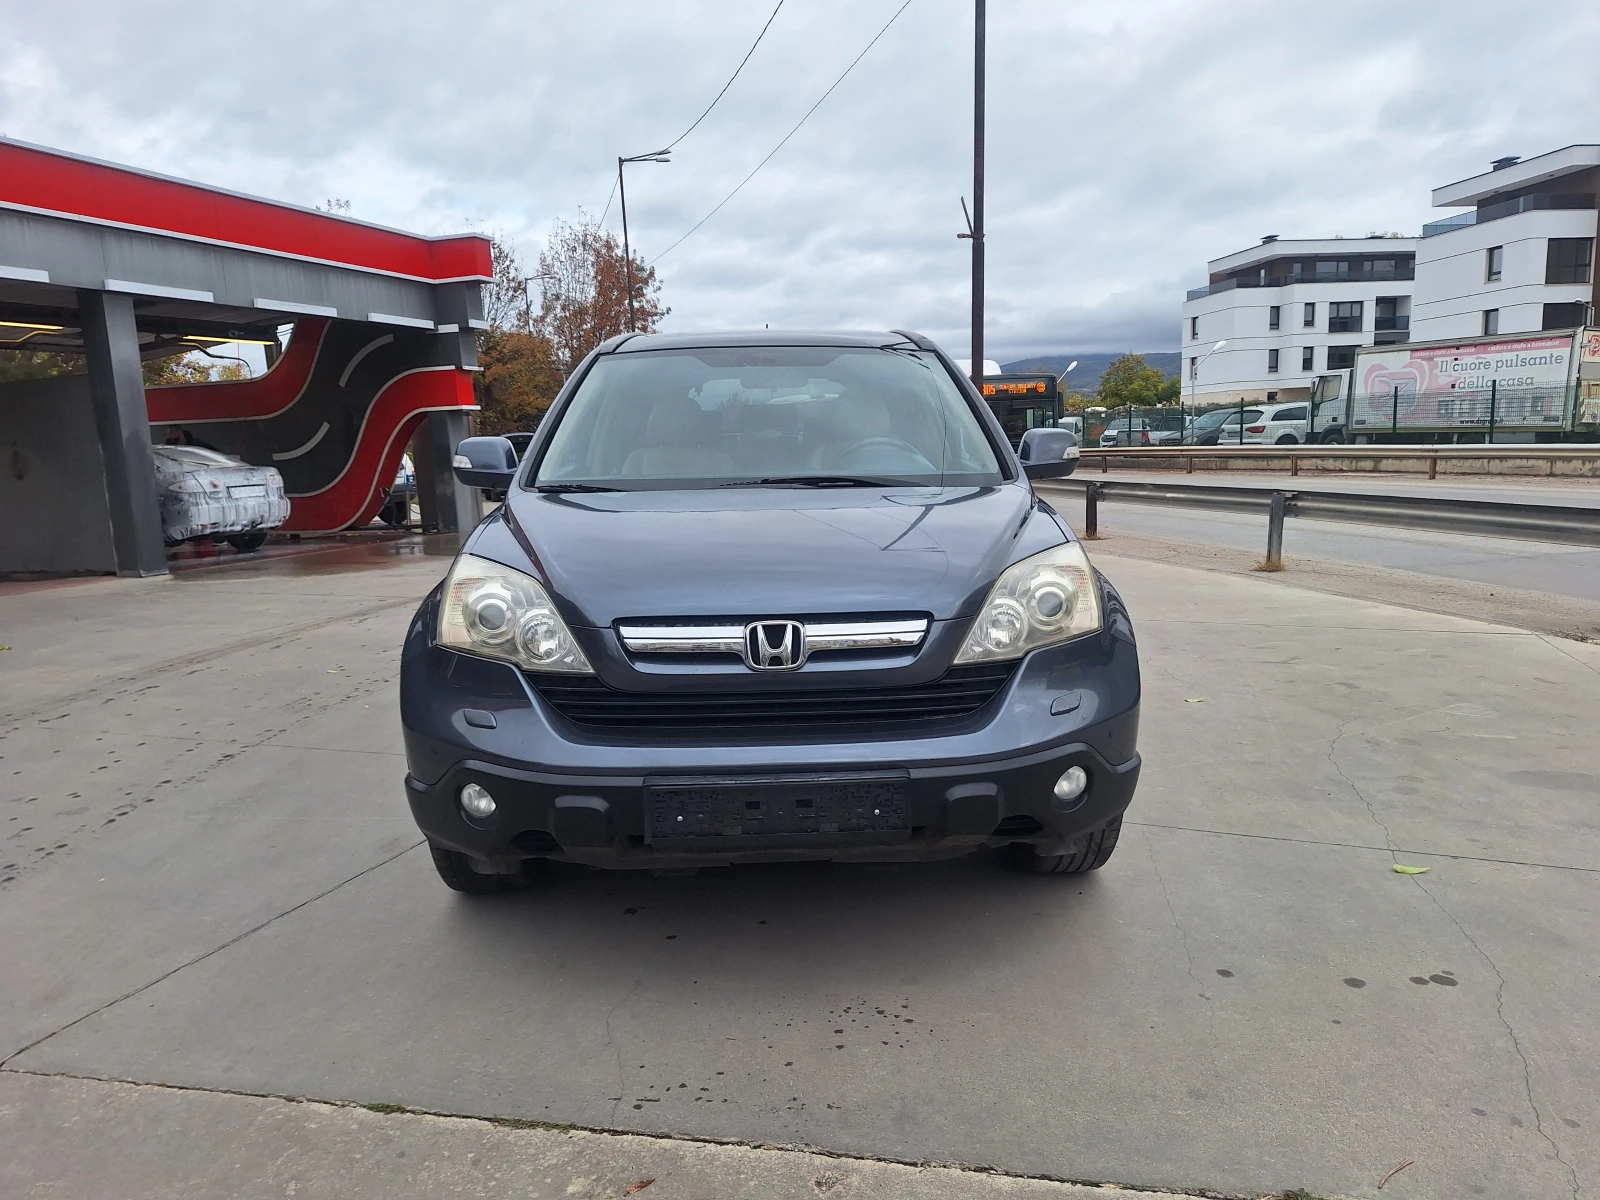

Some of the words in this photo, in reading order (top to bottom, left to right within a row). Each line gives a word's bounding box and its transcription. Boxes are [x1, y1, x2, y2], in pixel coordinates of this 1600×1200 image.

[1439, 360, 1449, 373] Il
[1452, 360, 1492, 372] cuore
[1494, 353, 1564, 372] pulsante
[1498, 376, 1535, 387] casa
